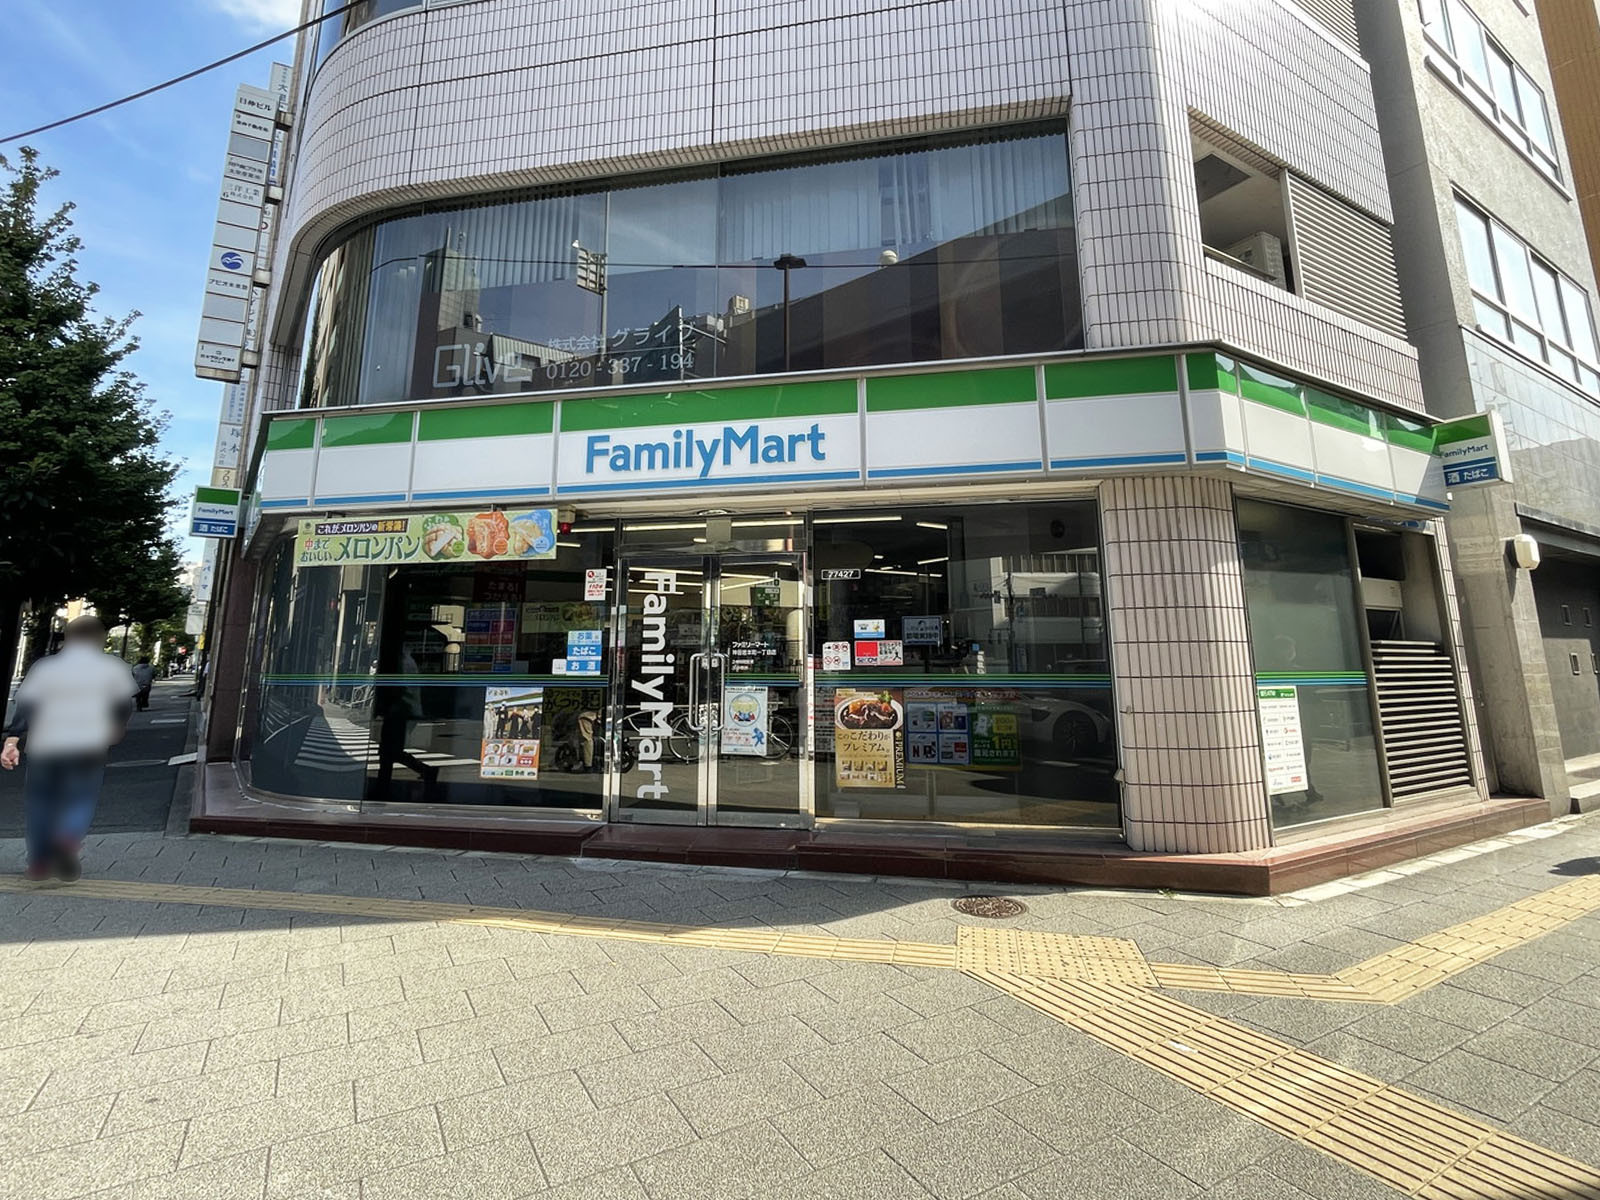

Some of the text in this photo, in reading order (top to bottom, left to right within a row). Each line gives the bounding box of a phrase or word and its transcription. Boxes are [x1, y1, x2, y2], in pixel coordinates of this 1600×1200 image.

[548, 337, 605, 352] 株式会社
[546, 360, 592, 380] 0120
[659, 352, 694, 371] 194
[586, 423, 826, 478] FamilyMart
[1447, 468, 1489, 483] 酒 たばこ
[198, 507, 234, 515] FamilyMart
[210, 525, 229, 533] たばこ
[304, 537, 330, 551] 中まで
[334, 535, 421, 561] メロンパン
[300, 551, 333, 562] おいしい
[827, 570, 854, 578] 77427
[572, 646, 597, 656] たばこ
[631, 571, 677, 800] FamilyMart
